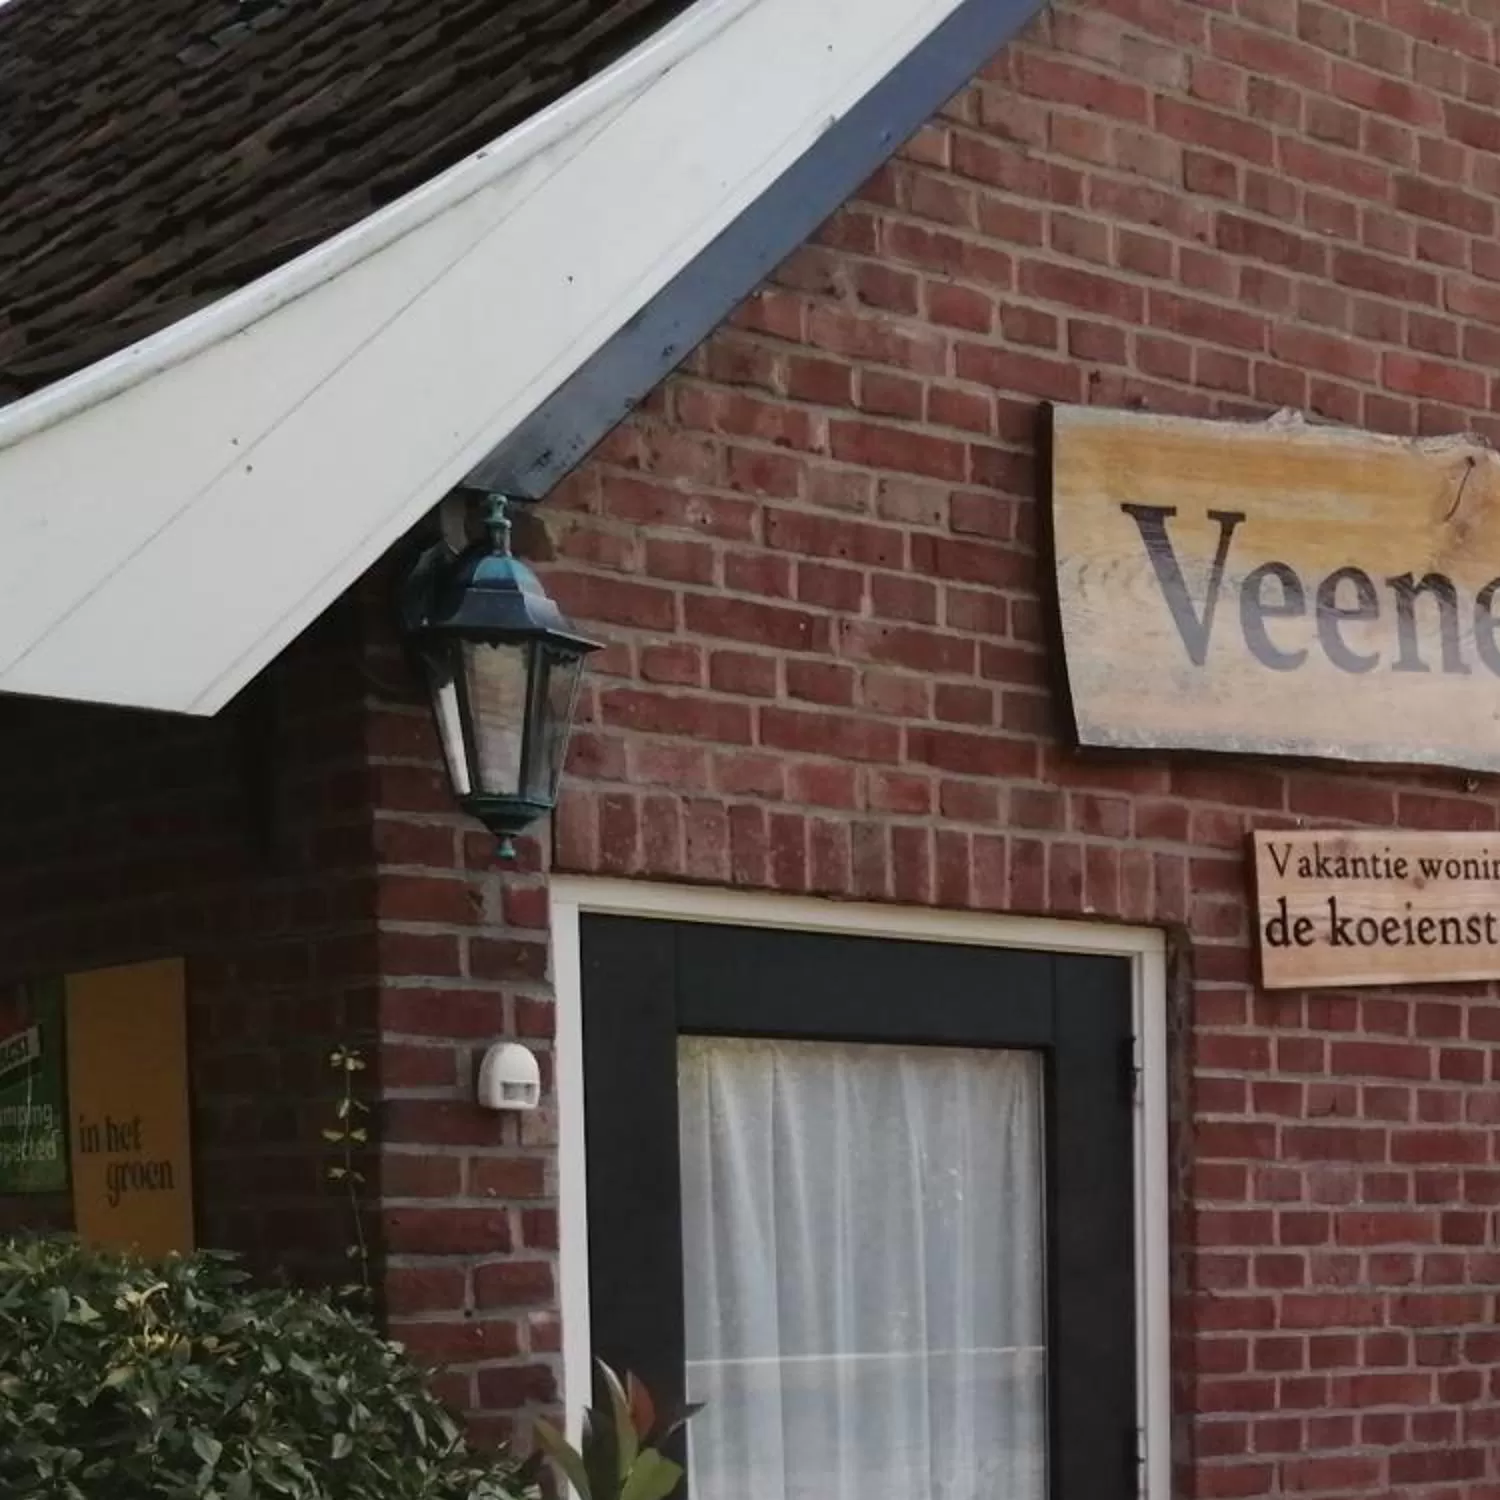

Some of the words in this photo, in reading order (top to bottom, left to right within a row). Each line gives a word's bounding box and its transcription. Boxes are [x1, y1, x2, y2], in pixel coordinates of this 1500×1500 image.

[1267, 842, 1408, 880] Vakantie
[1265, 896, 1314, 947] de
[78, 1115, 99, 1153] in
[106, 1115, 143, 1153] het
[105, 1158, 174, 1208] groen
